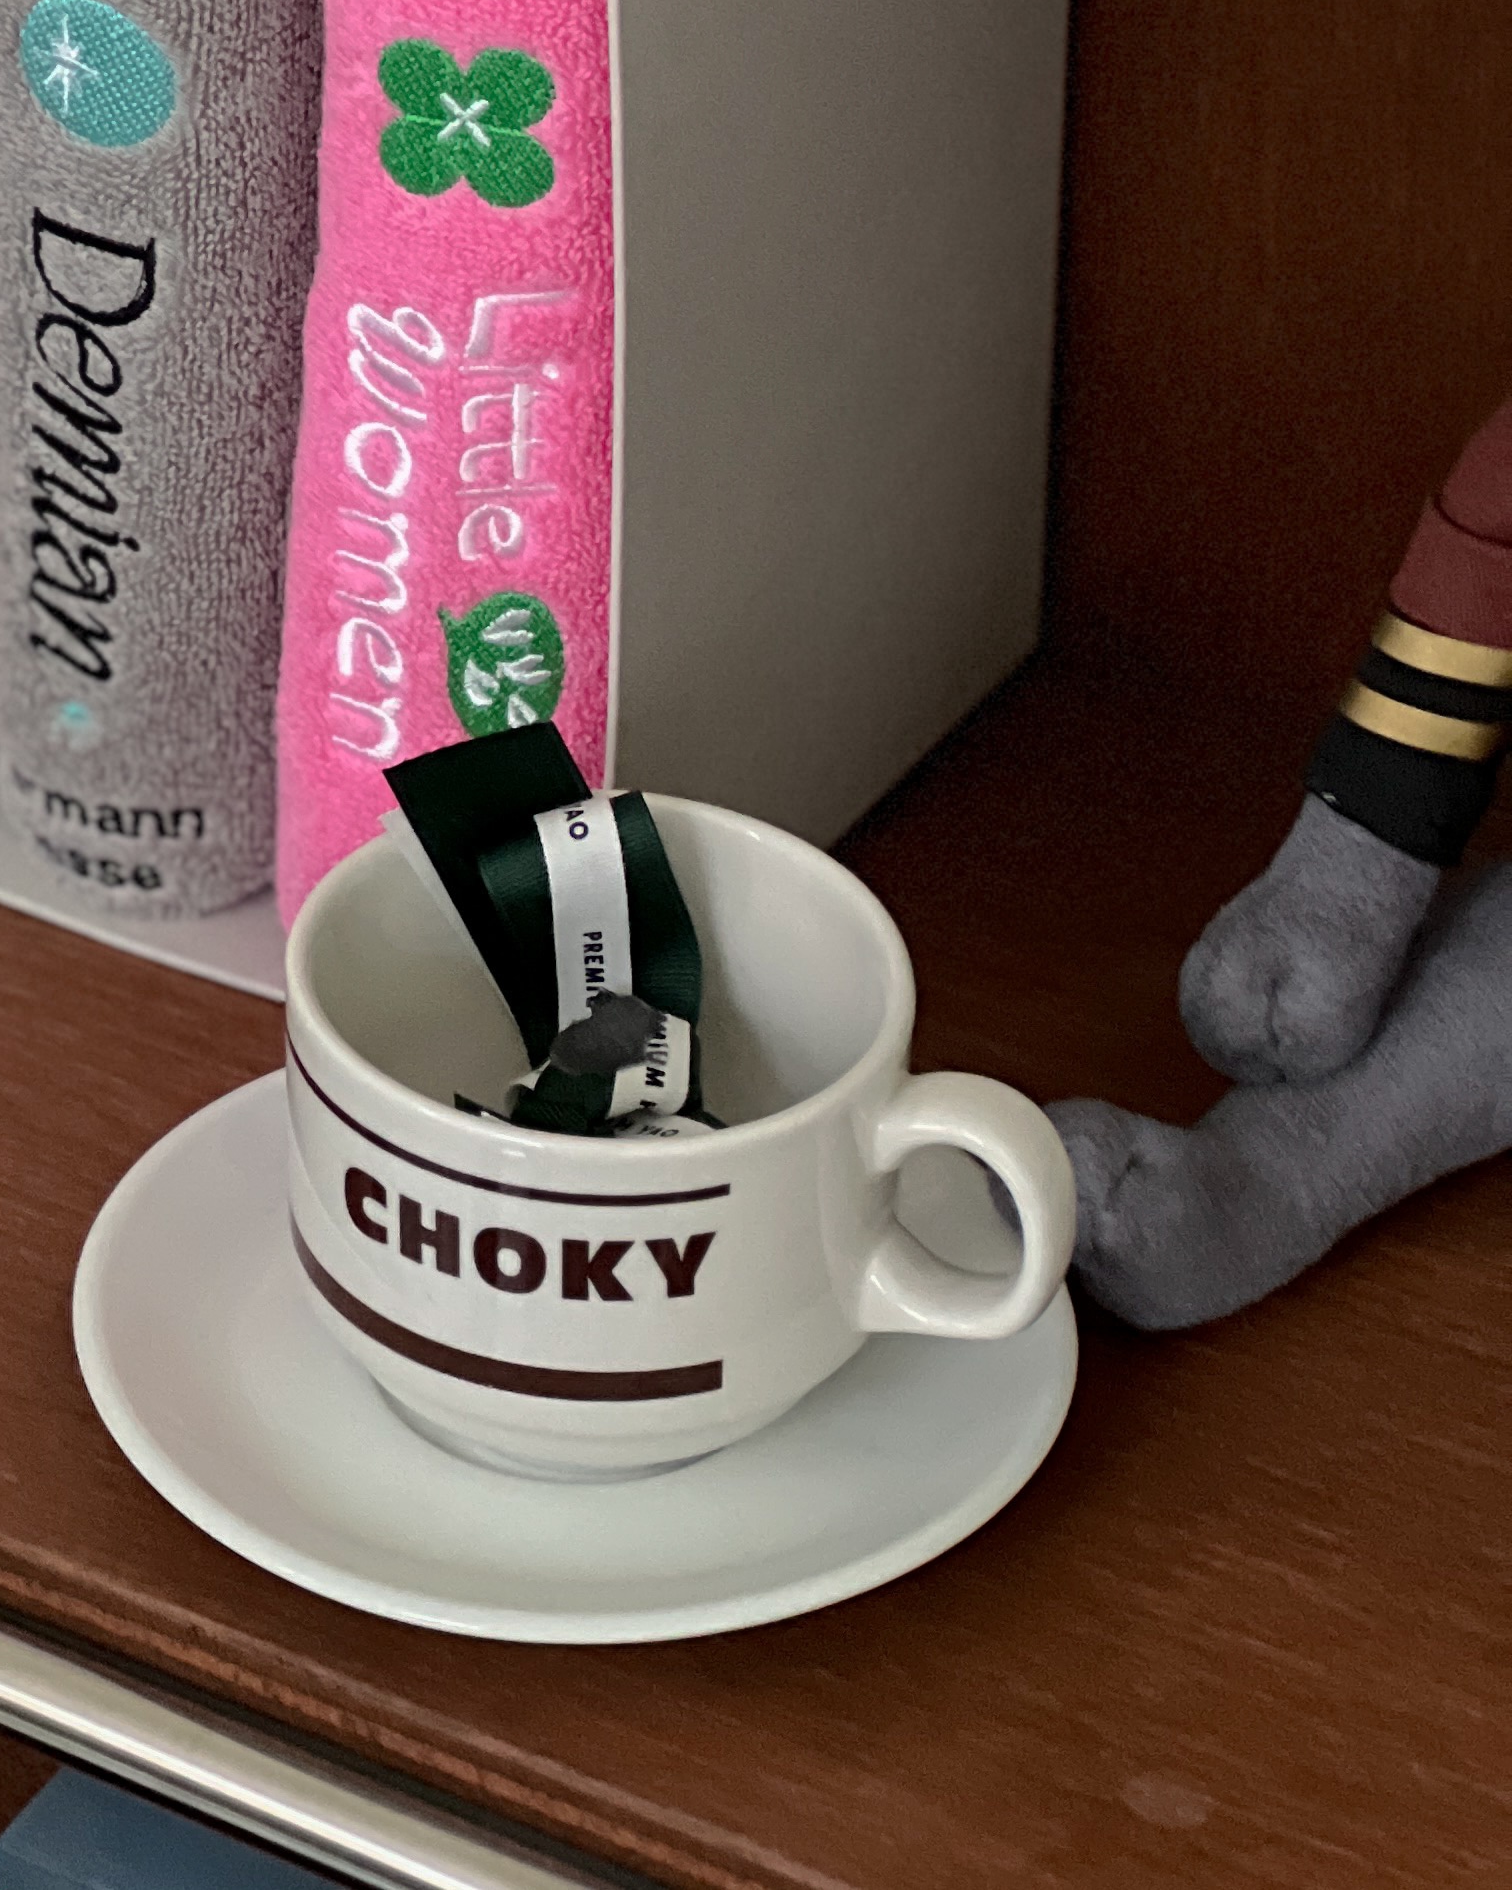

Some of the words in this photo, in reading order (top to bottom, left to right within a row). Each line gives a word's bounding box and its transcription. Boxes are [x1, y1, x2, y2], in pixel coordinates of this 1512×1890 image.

[29, 207, 156, 683] Demian
[330, 303, 446, 760] Women
[454, 289, 577, 562] Little
[345, 1166, 717, 1302] CHOKY
